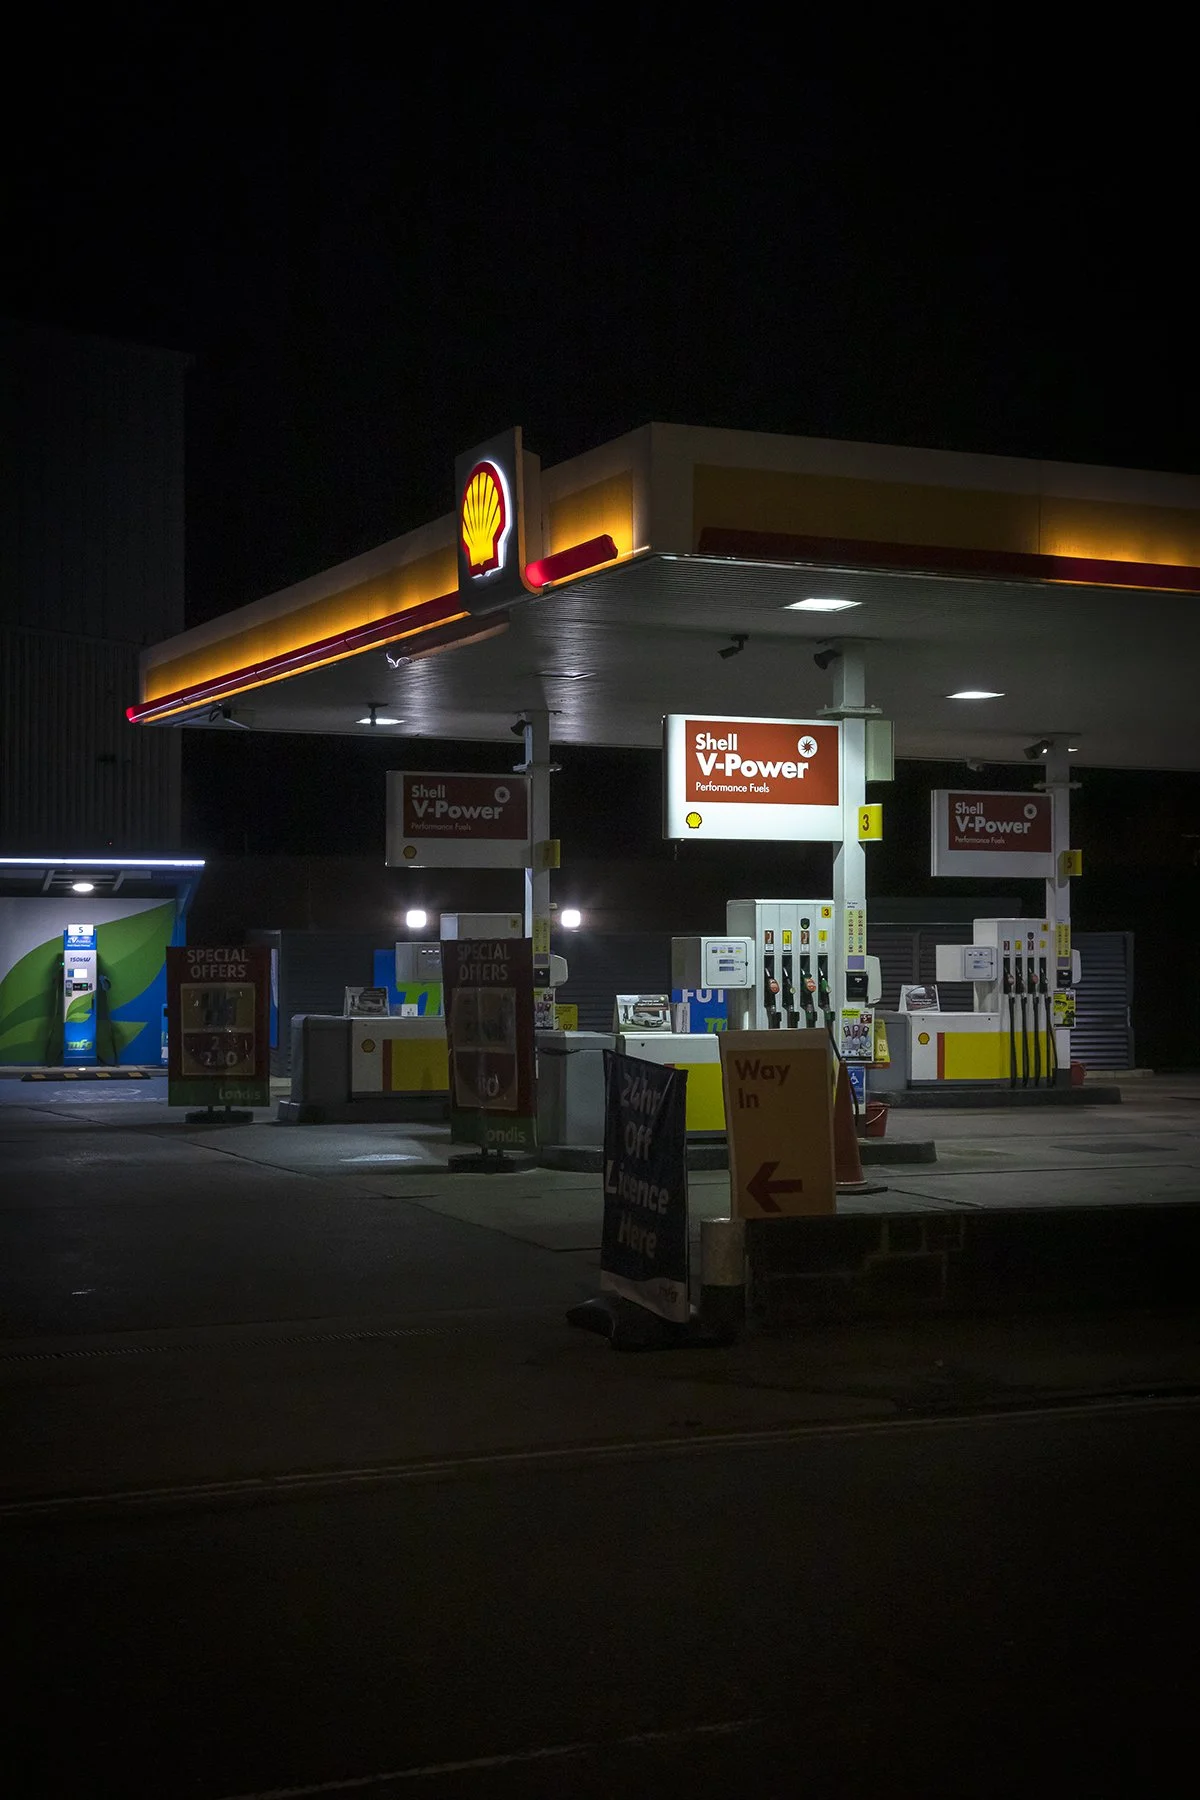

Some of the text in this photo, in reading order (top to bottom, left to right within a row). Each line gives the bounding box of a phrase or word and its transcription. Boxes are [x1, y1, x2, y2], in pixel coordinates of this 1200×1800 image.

[695, 732, 738, 751] Shell
[696, 752, 809, 778] V-Power
[411, 784, 446, 799] Shell
[695, 781, 770, 793] Performance Fuels
[411, 800, 504, 820] V-Power
[954, 801, 984, 815] Shell
[410, 821, 472, 832] Performance Fuels
[861, 813, 870, 831] 3
[955, 816, 1032, 834] V-Power
[954, 835, 1006, 845] Performance Fuels
[824, 908, 830, 917] 3
[186, 949, 249, 964] SPECIAL
[457, 943, 511, 961] SPECIAL
[190, 964, 247, 979] OFFERS
[735, 1059, 791, 1086] Way
[738, 1087, 759, 1108] In
[624, 1120, 653, 1160] Off
[618, 1210, 657, 1259] Here
